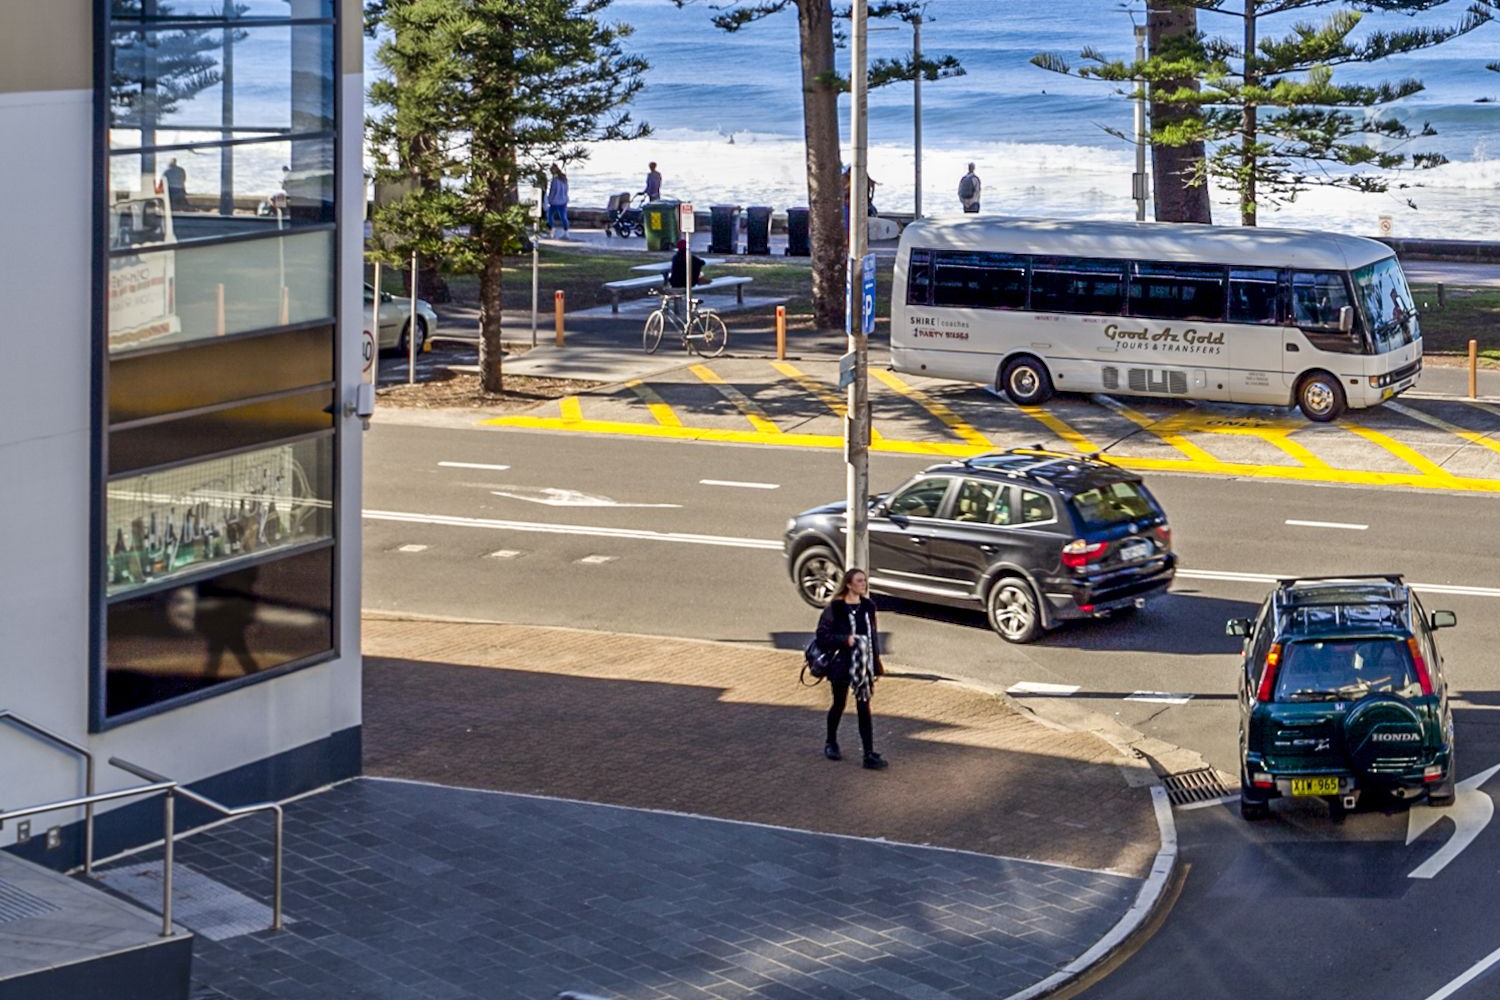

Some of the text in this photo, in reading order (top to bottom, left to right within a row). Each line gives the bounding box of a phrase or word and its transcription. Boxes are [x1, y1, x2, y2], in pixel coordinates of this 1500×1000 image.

[910, 316, 969, 328] SHIRE coaches
[919, 330, 944, 338] PARTY
[1104, 324, 1225, 345] Good Az Gold
[1116, 341, 1149, 350] TOURS
[1162, 344, 1221, 355] TRANSFERS
[1372, 733, 1421, 741] HONDA
[1319, 778, 1336, 790] 965
